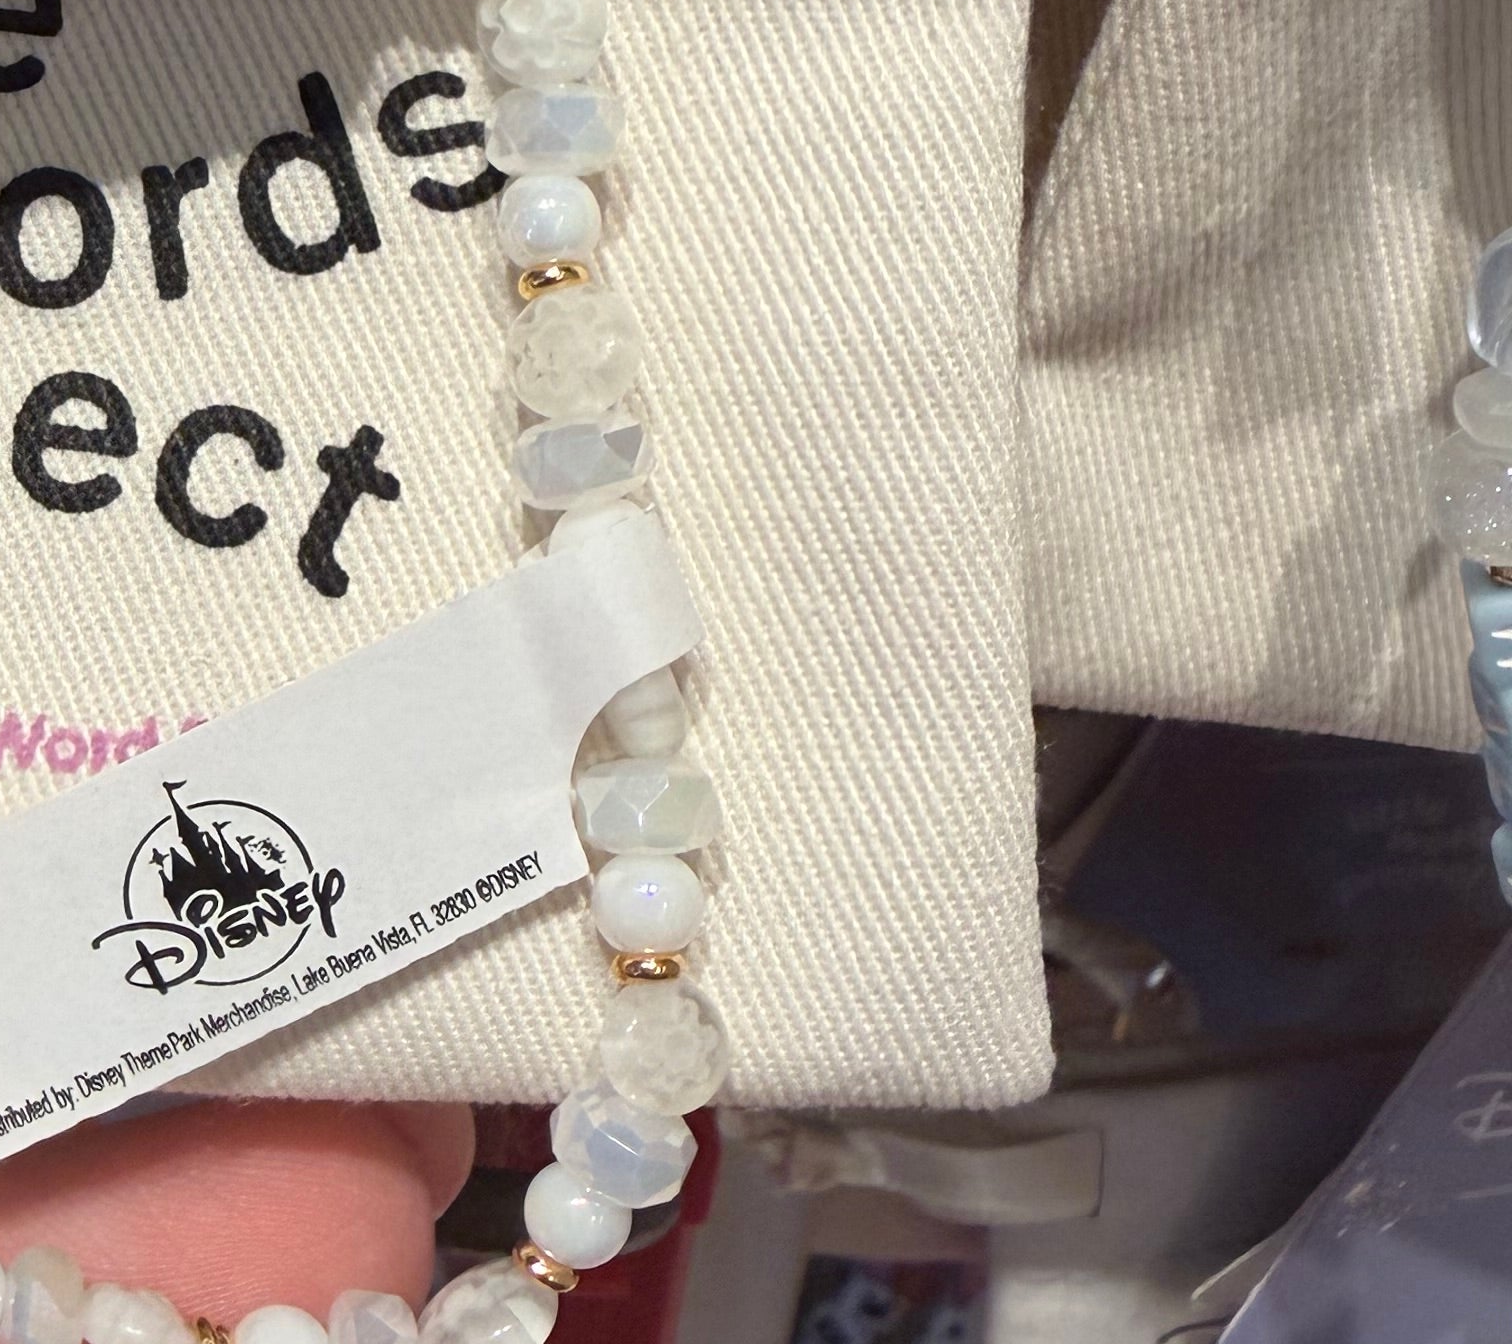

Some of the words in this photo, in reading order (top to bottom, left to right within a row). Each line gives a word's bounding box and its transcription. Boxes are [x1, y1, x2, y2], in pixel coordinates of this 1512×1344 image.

[50, 1085, 80, 1111] by:
[74, 1063, 127, 1098] Disney
[120, 1042, 173, 1075] Theme
[167, 1023, 206, 1055] Park
[199, 985, 299, 1040] Merchandise,
[291, 966, 331, 996] Lake
[326, 943, 377, 978] Buena
[371, 925, 418, 956] Vista,
[409, 911, 435, 937] FL
[430, 887, 478, 927] 32830
[92, 866, 346, 994] Disney
